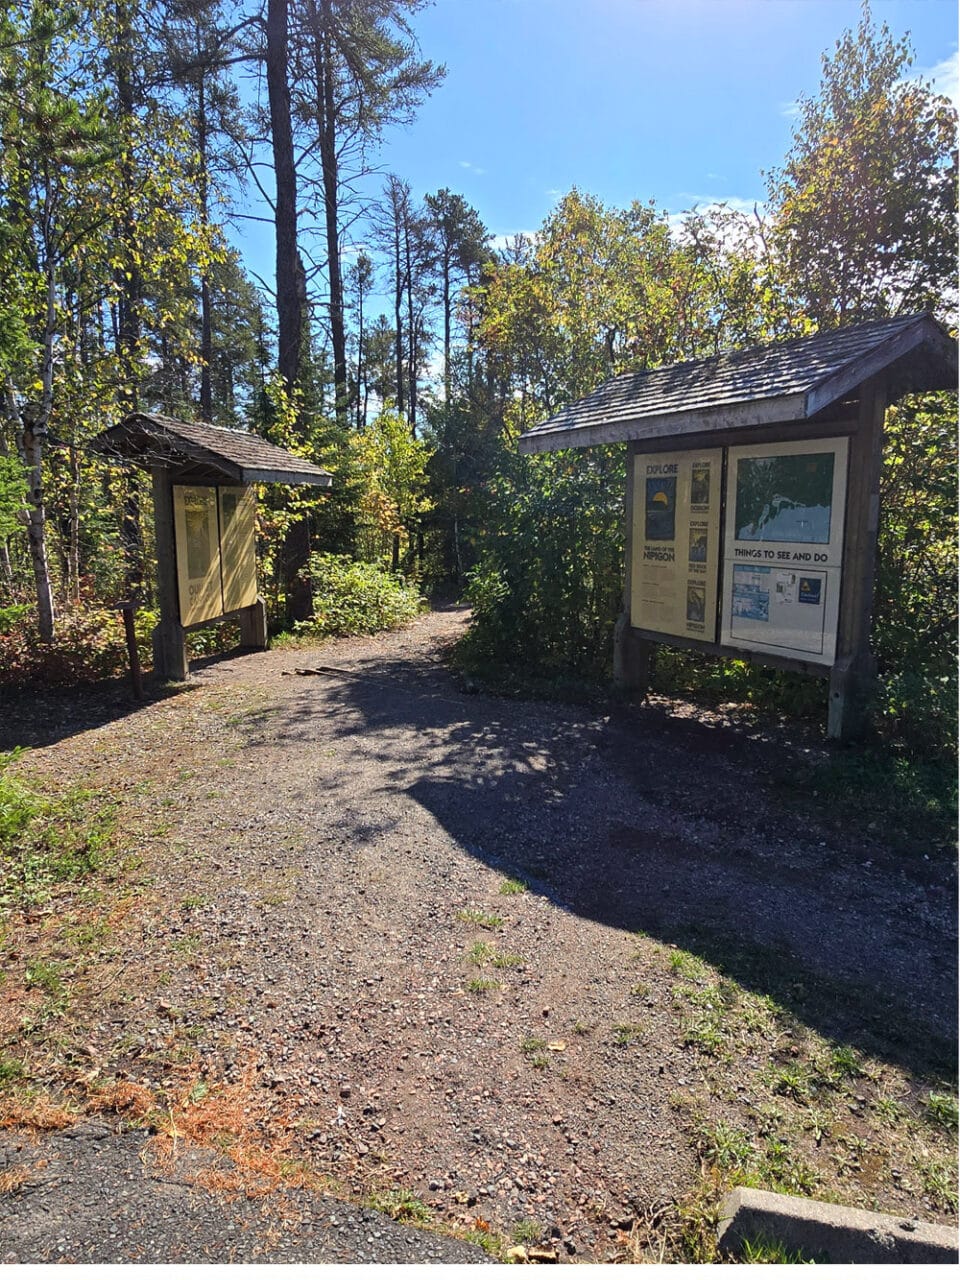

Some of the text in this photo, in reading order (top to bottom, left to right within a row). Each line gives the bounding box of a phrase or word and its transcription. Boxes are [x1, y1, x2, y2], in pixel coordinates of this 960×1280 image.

[646, 463, 678, 474] EXPLORE
[643, 551, 675, 562] NIPIGON
[734, 548, 828, 562] THINGS TO SEE AND DO
